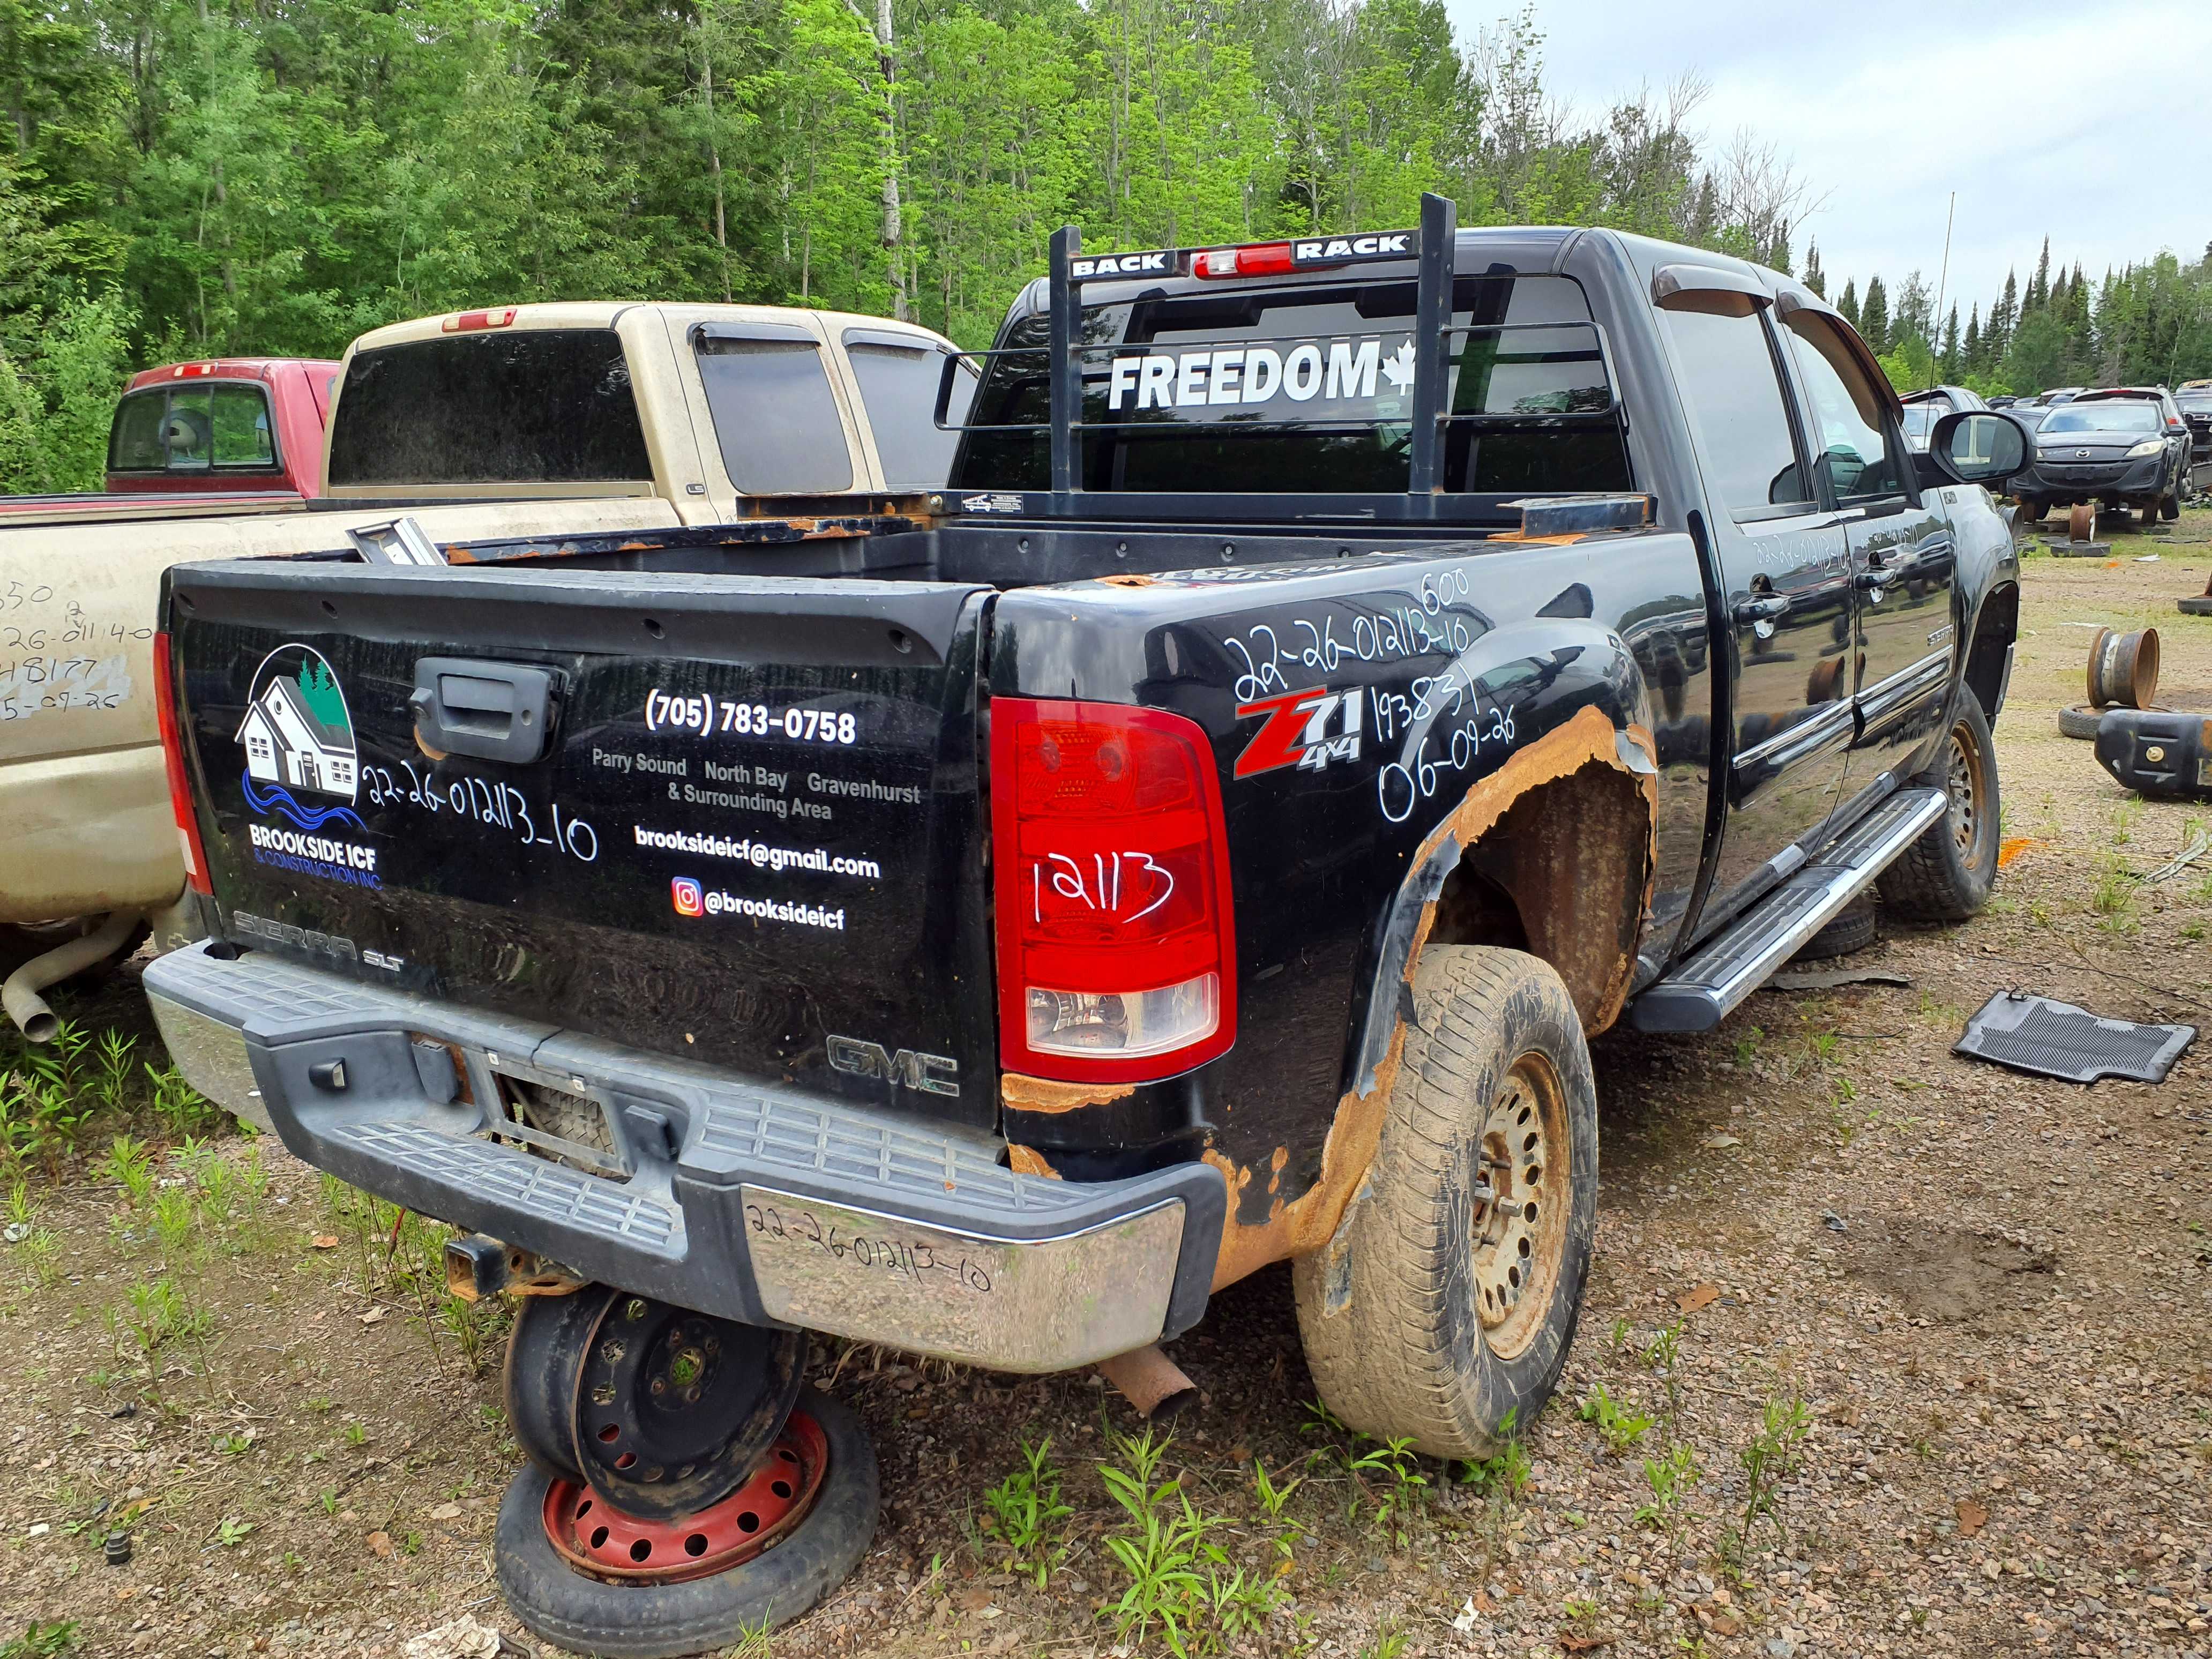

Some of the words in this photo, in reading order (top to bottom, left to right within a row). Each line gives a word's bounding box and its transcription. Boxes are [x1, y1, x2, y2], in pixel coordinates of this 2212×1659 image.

[1072, 253, 1165, 277] BACK
[1297, 235, 1408, 260] RACK
[1108, 341, 1381, 410] FREEDOM
[687, 485, 704, 493] LS
[1421, 567, 1469, 616] 600
[1224, 606, 1469, 703] 22-26-012113-10
[645, 689, 714, 737] (705)
[720, 701, 856, 744] 783-0758
[1234, 684, 1363, 780] Z71
[592, 748, 632, 773] Parry
[636, 753, 686, 776] Sound
[705, 763, 750, 784] North
[754, 767, 788, 791] Bay
[1379, 704, 1514, 822] 06-09-26
[668, 782, 681, 800] &
[684, 781, 787, 819] Surrounding
[791, 798, 832, 820] Area
[807, 773, 921, 804] Gravenhurst
[249, 824, 346, 865] BROOKSIDE
[346, 844, 376, 871] ICF
[253, 848, 266, 864] &
[265, 850, 358, 885] CONSTRUCTION
[358, 871, 383, 891] INC
[634, 825, 880, 878] brooksideicf@gmail.com
[704, 891, 845, 930] @brooksideicf
[1034, 851, 1175, 924] 12113
[233, 910, 357, 961] SIERRA
[363, 950, 404, 972] SLT
[826, 1034, 960, 1097] GMC
